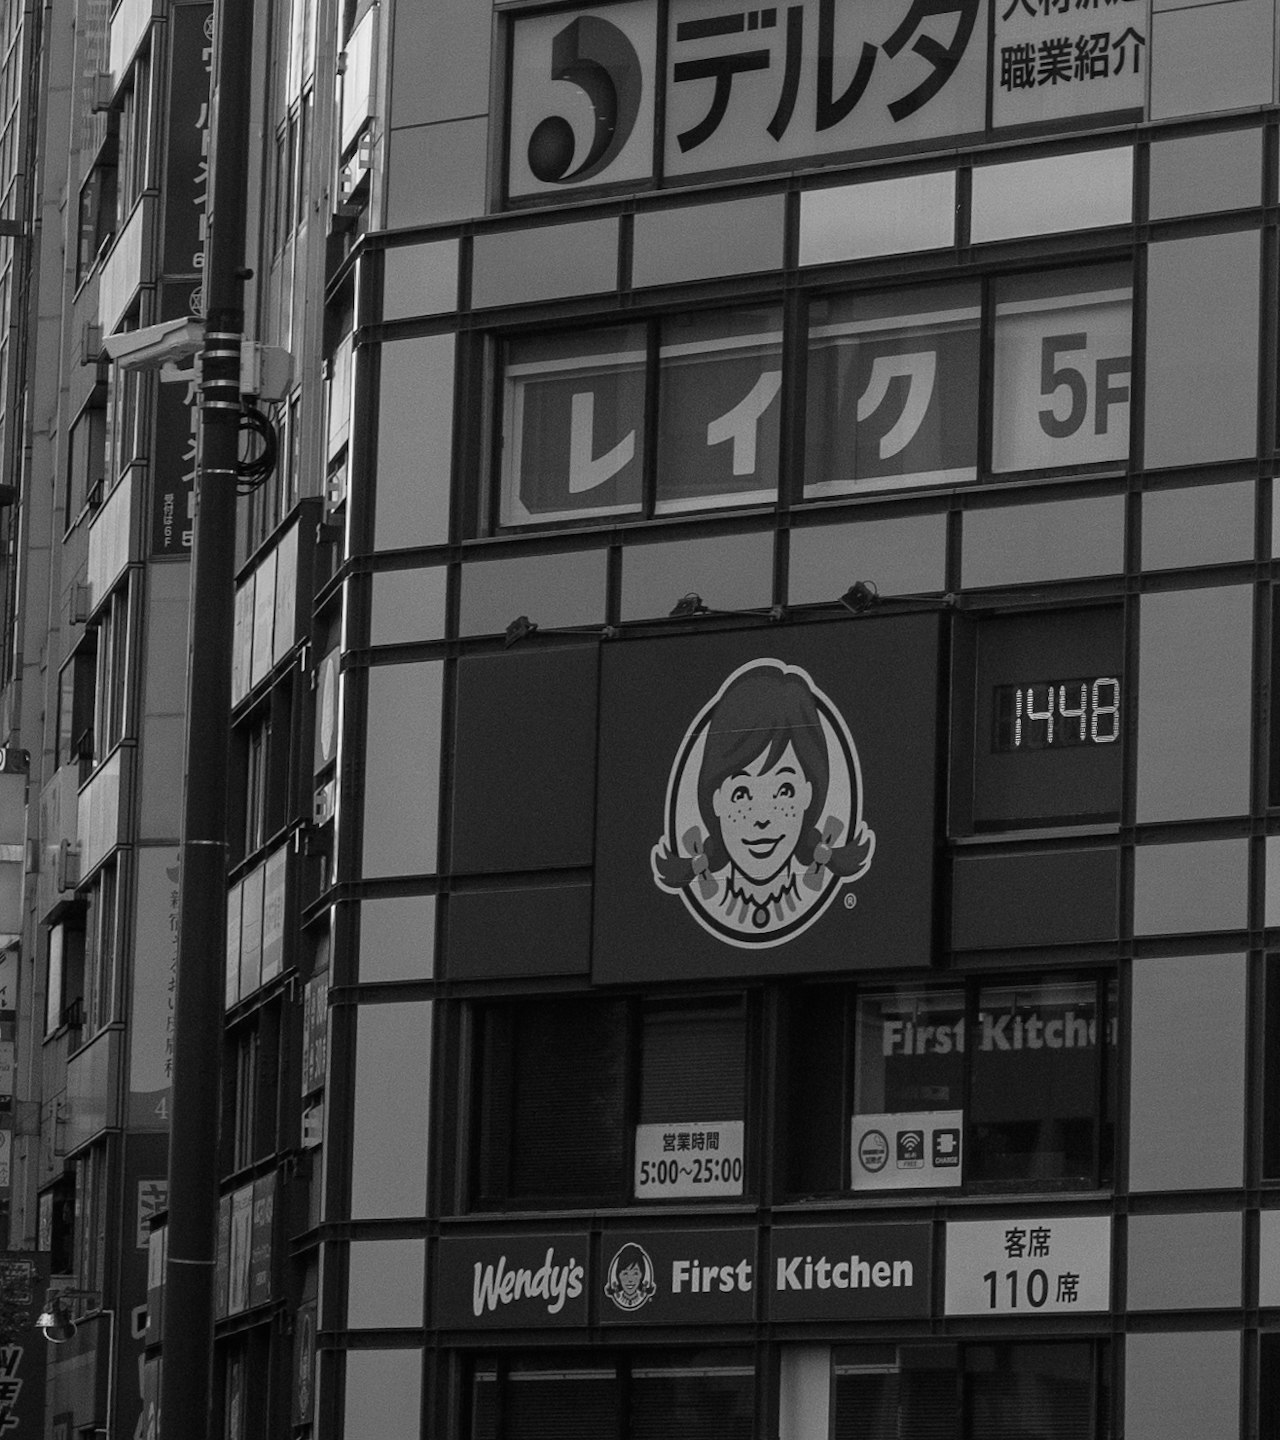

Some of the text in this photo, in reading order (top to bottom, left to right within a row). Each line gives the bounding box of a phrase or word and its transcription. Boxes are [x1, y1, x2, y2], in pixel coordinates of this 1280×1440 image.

[999, 26, 1146, 93] 職業紹介
[1037, 331, 1131, 440] 5F
[568, 349, 937, 494] レイク
[661, 1130, 720, 1152] 営業時間
[1005, 1226, 1052, 1259] 客席
[472, 1246, 914, 1318] Wendy's First Kitchen
